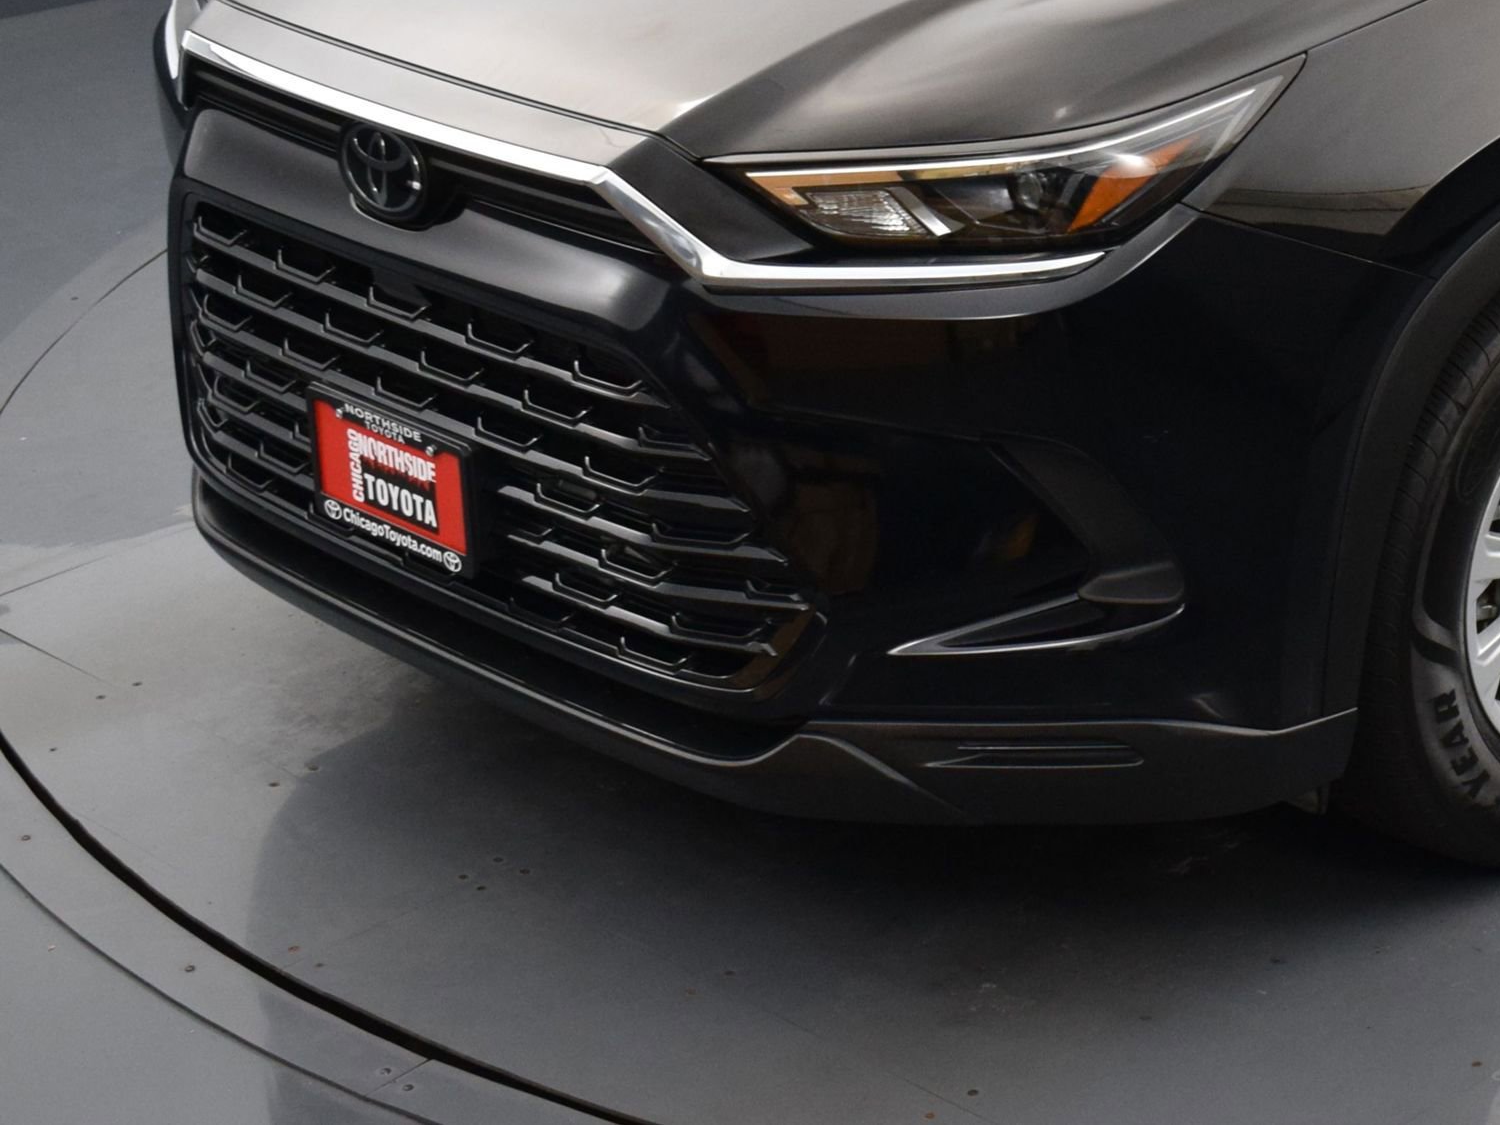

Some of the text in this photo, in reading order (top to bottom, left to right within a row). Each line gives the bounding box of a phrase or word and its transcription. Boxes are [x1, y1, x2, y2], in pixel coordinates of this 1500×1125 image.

[344, 402, 422, 443] NORTHSIDE
[364, 420, 406, 444] TOYOTA
[346, 428, 365, 503] CHICAGO
[356, 433, 437, 484] NORTHSIDE
[363, 472, 438, 528] TOYOTA
[343, 507, 443, 563] ChicagoToyota.com
